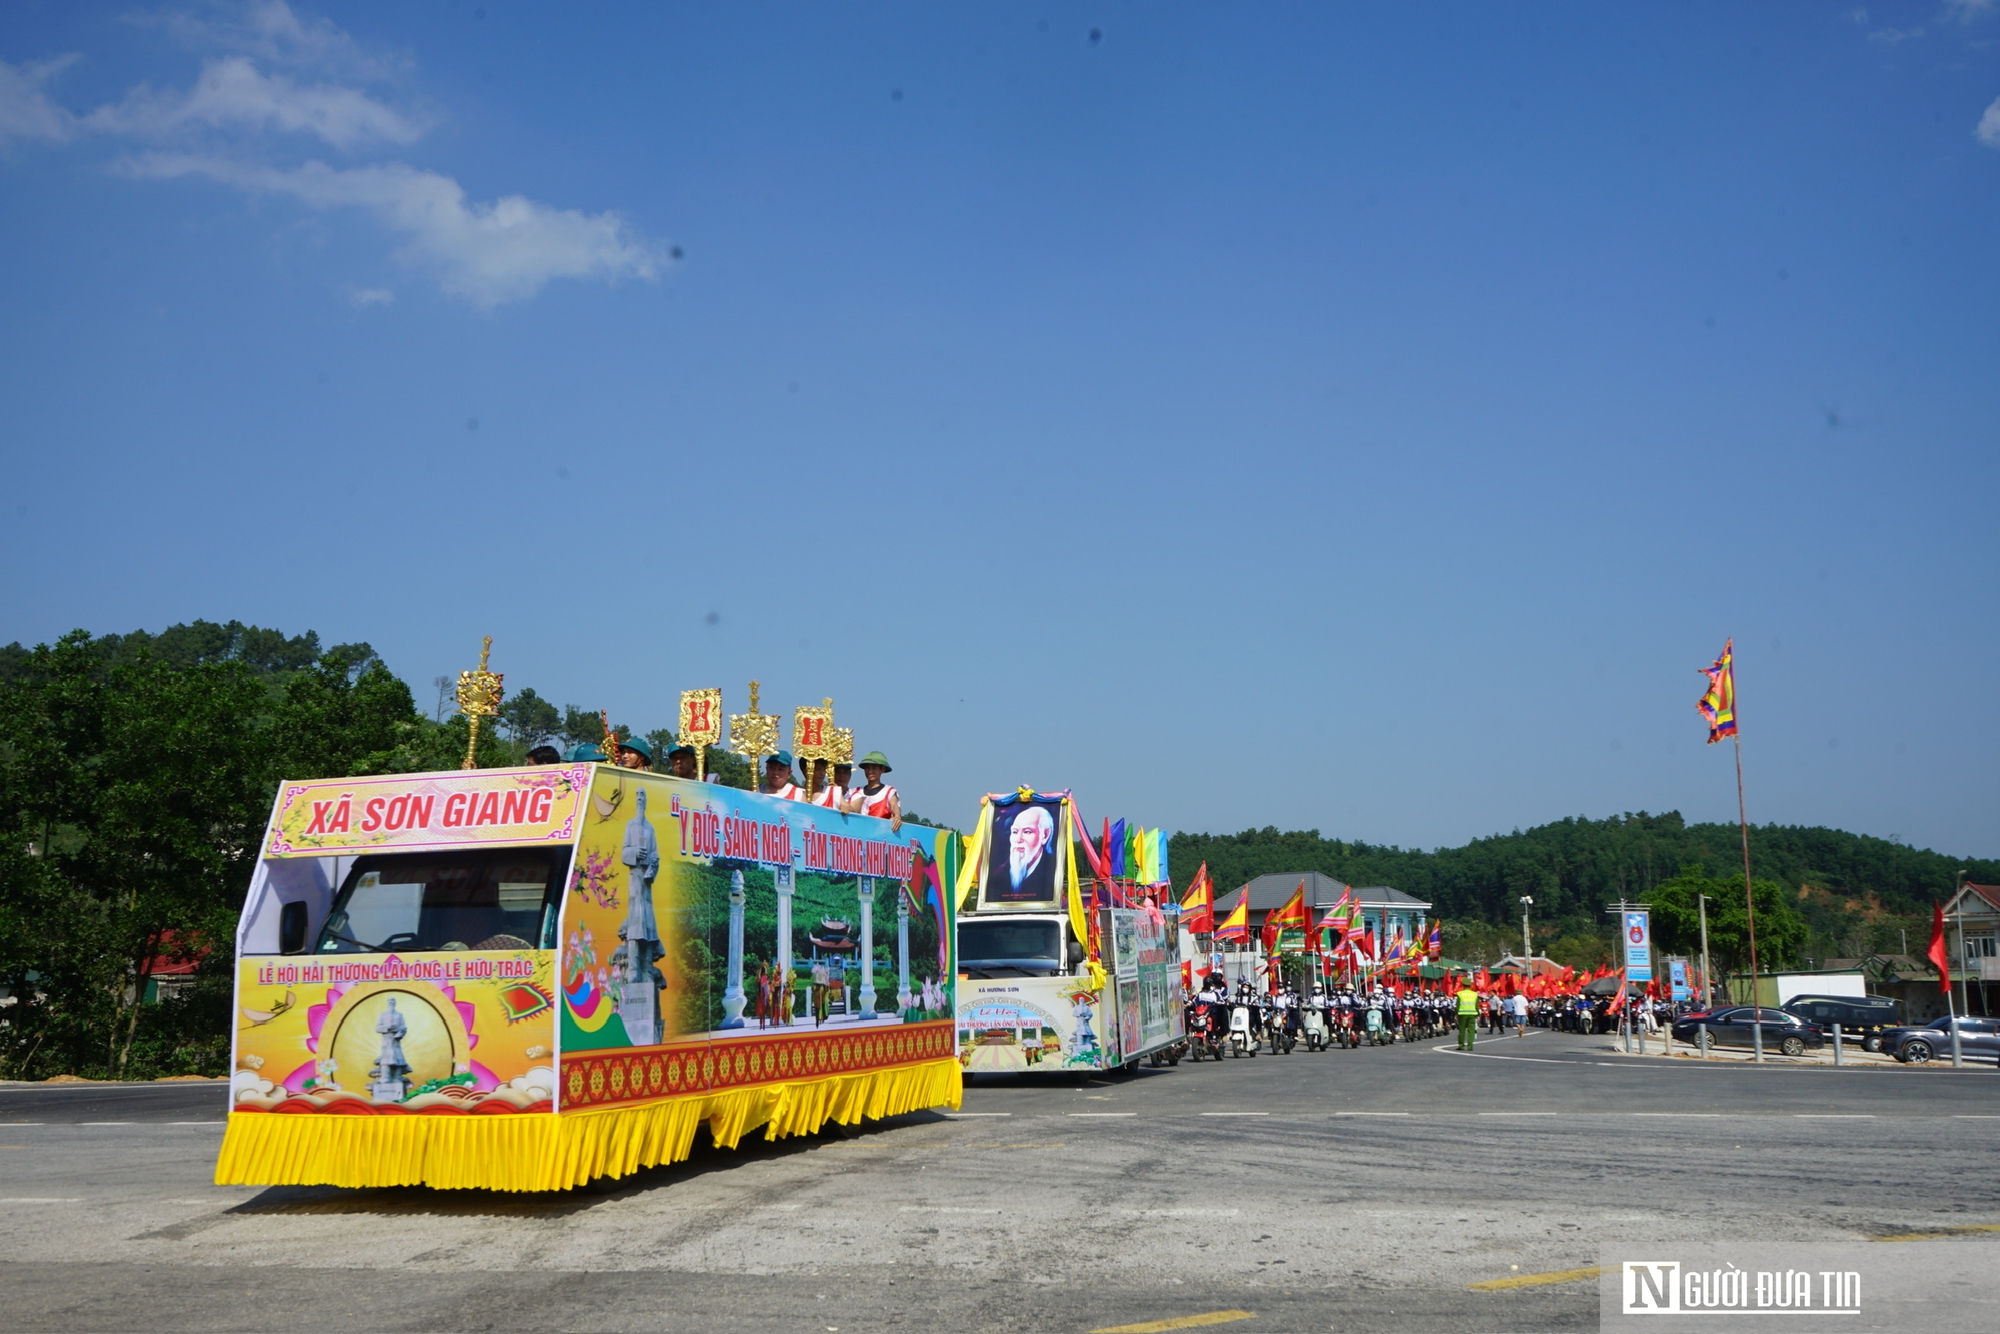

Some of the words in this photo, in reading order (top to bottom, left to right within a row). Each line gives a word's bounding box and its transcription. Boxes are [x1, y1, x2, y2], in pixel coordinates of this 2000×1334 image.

[304, 793, 354, 835] XÃ
[361, 793, 435, 832] SƠN
[442, 788, 554, 828] GIANG
[692, 802, 720, 859] ĐỨC
[723, 807, 759, 863] SÁNG
[762, 815, 791, 868] NGỜI
[803, 823, 828, 872] TÂM
[866, 838, 887, 878] NHƯ
[258, 962, 274, 985] LỄ
[277, 963, 299, 987] HỘI
[302, 961, 324, 984] HẢI
[328, 962, 380, 986] THƯỢNG
[382, 960, 410, 981] LÃN
[413, 959, 441, 981] ÔNG
[446, 959, 461, 980] LÊ
[465, 958, 493, 980] HỮU
[497, 956, 533, 979] TRÁC
